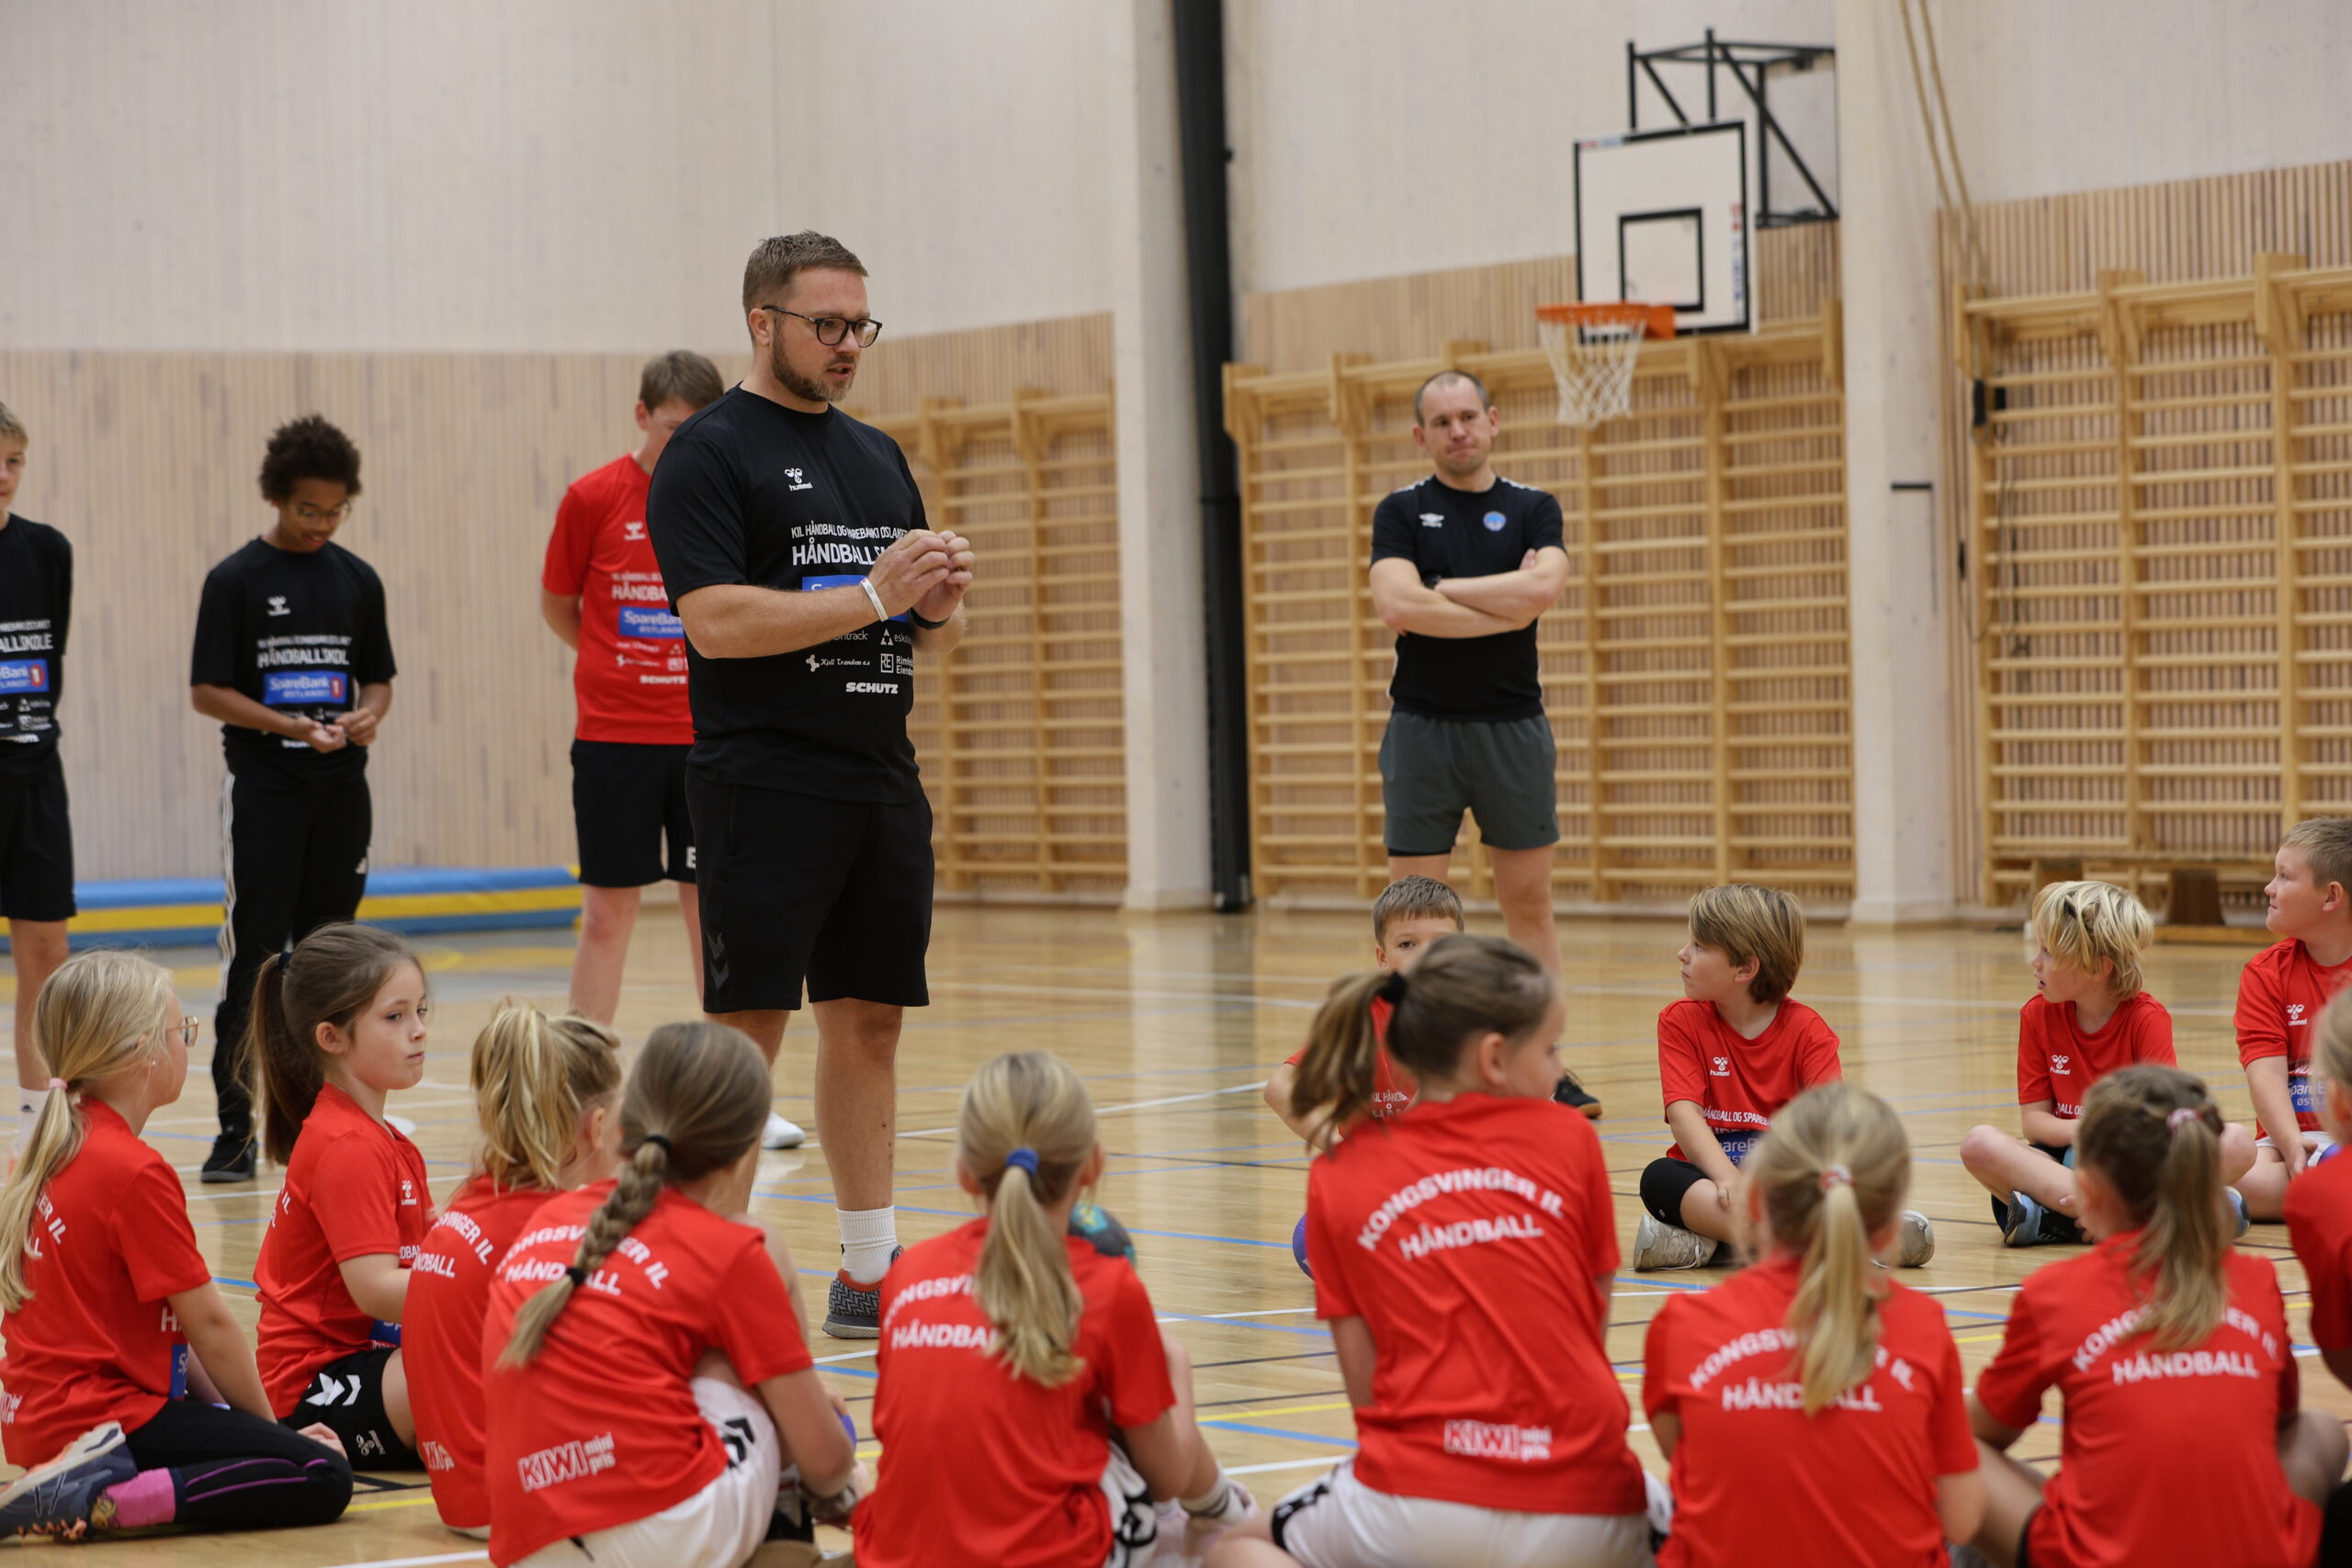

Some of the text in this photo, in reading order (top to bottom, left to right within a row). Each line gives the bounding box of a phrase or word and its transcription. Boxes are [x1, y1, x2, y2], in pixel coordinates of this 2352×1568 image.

[791, 525, 805, 539] KIL
[805, 520, 837, 536] HÅNDBALL
[845, 682, 899, 694] SCHUTZ
[2050, 1066, 2071, 1076] hummel
[1733, 1111, 1743, 1122] OG
[1357, 1167, 1564, 1252] KONGSVINGER IL
[49, 1216, 66, 1245] IL
[1398, 1213, 1544, 1262] HÅNDBALL
[474, 1237, 494, 1266] IL
[645, 1260, 669, 1291] IL
[2112, 1348, 2261, 1385] HÅNDBALL
[1443, 1418, 1520, 1460] KIWI
[517, 1439, 589, 1494] KIWI
